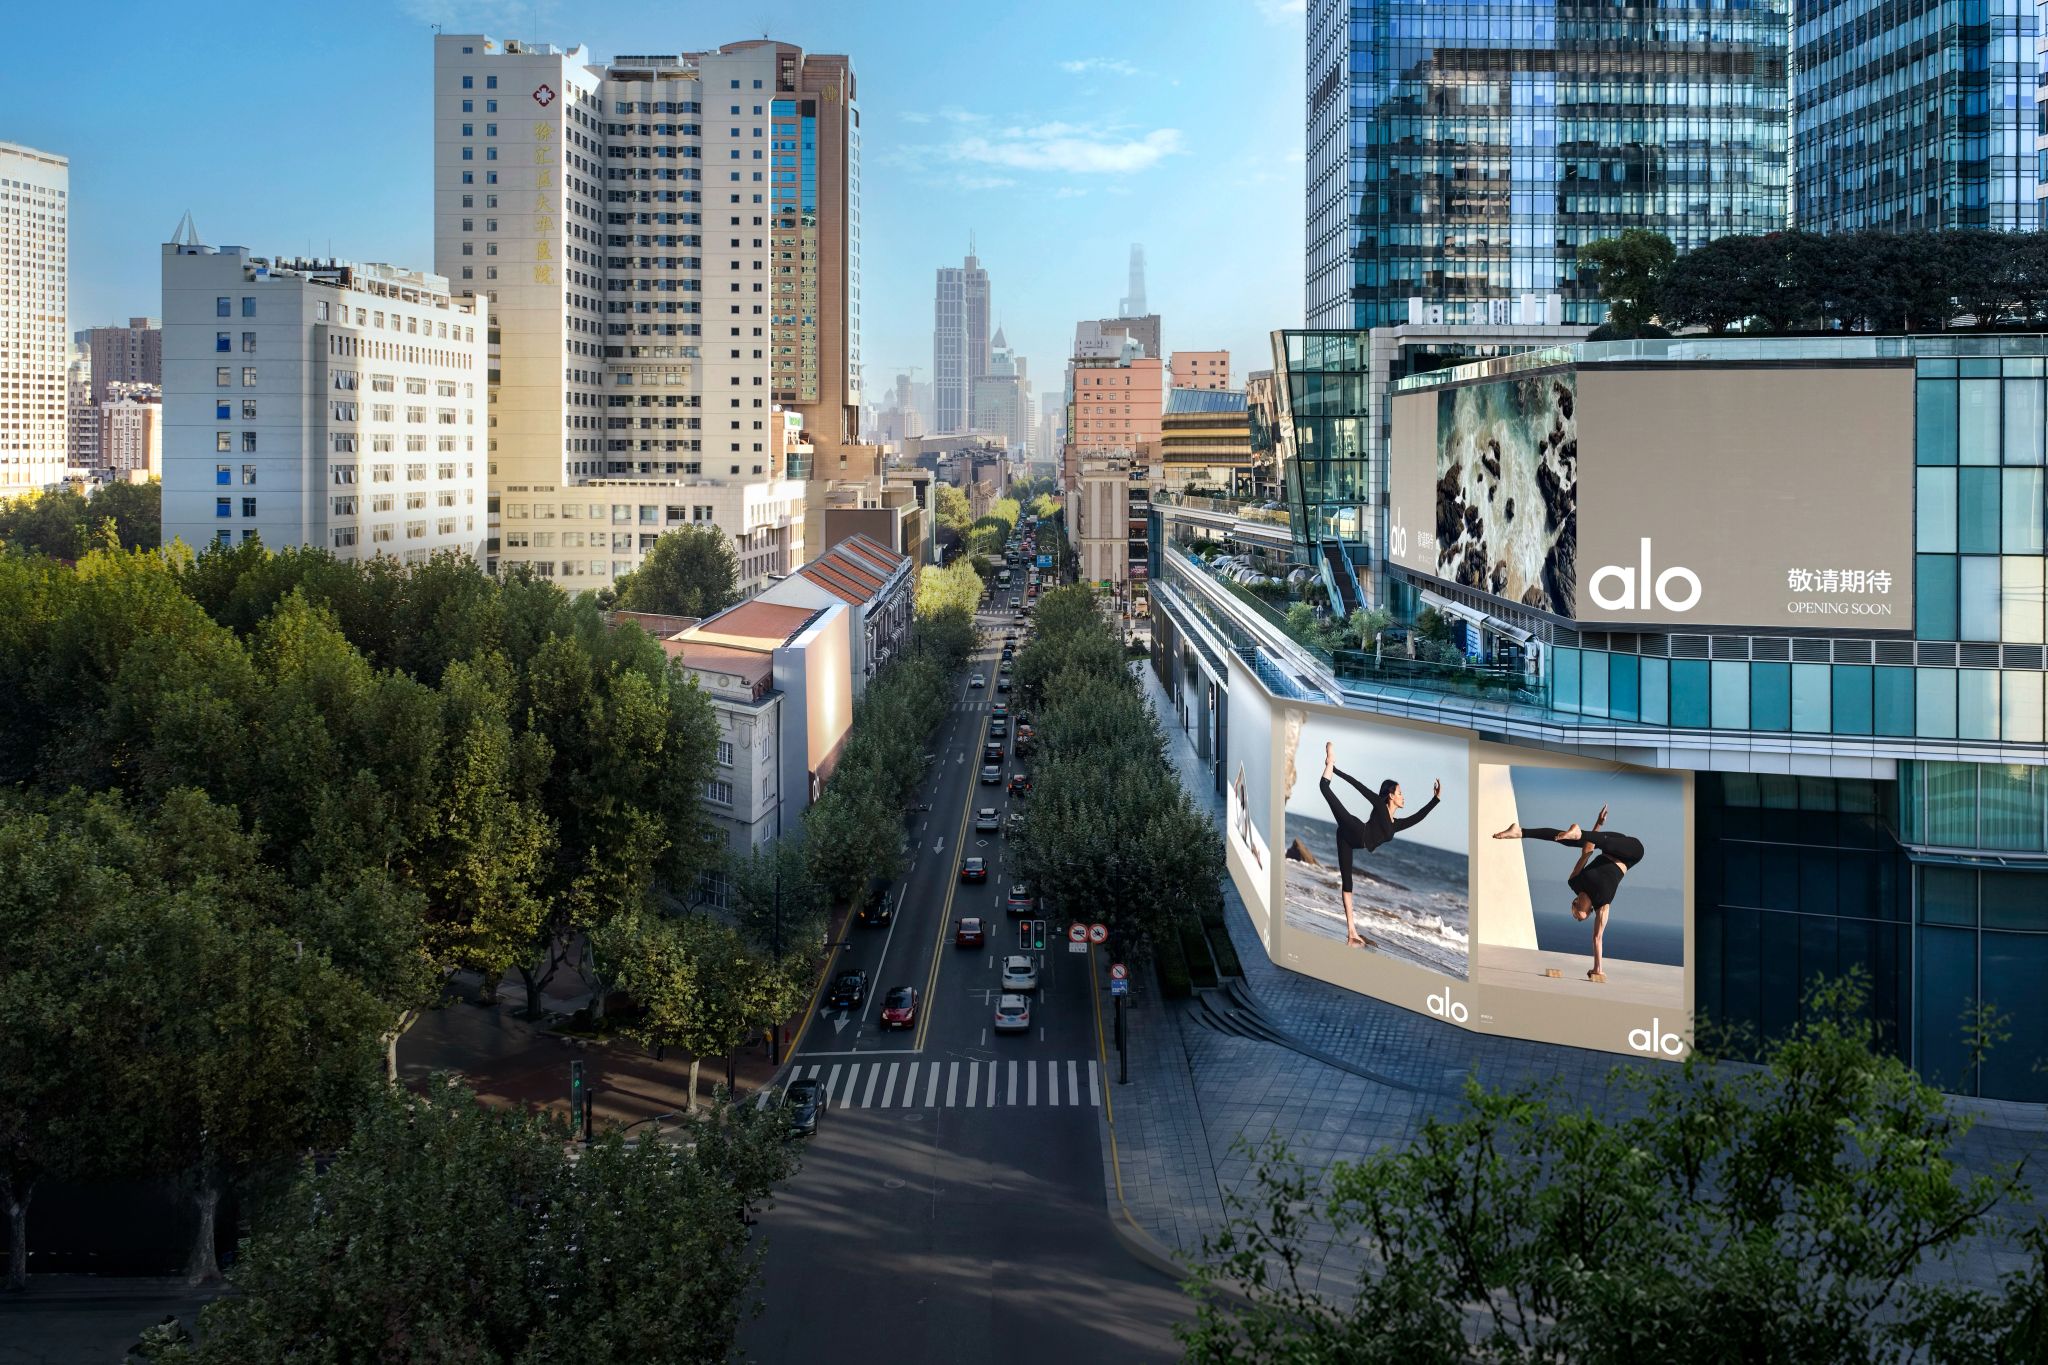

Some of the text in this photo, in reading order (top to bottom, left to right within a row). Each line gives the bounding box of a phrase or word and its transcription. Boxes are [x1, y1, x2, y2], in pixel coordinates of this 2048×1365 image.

[533, 121, 555, 285] 徐汇区大华医院
[1391, 507, 1406, 558] alo
[1589, 537, 1702, 612] alo
[1787, 567, 1892, 594] 敬请期待
[1787, 601, 1892, 616] OPENING SOON
[1426, 986, 1469, 1023] alo
[1628, 1018, 1684, 1056] alo
